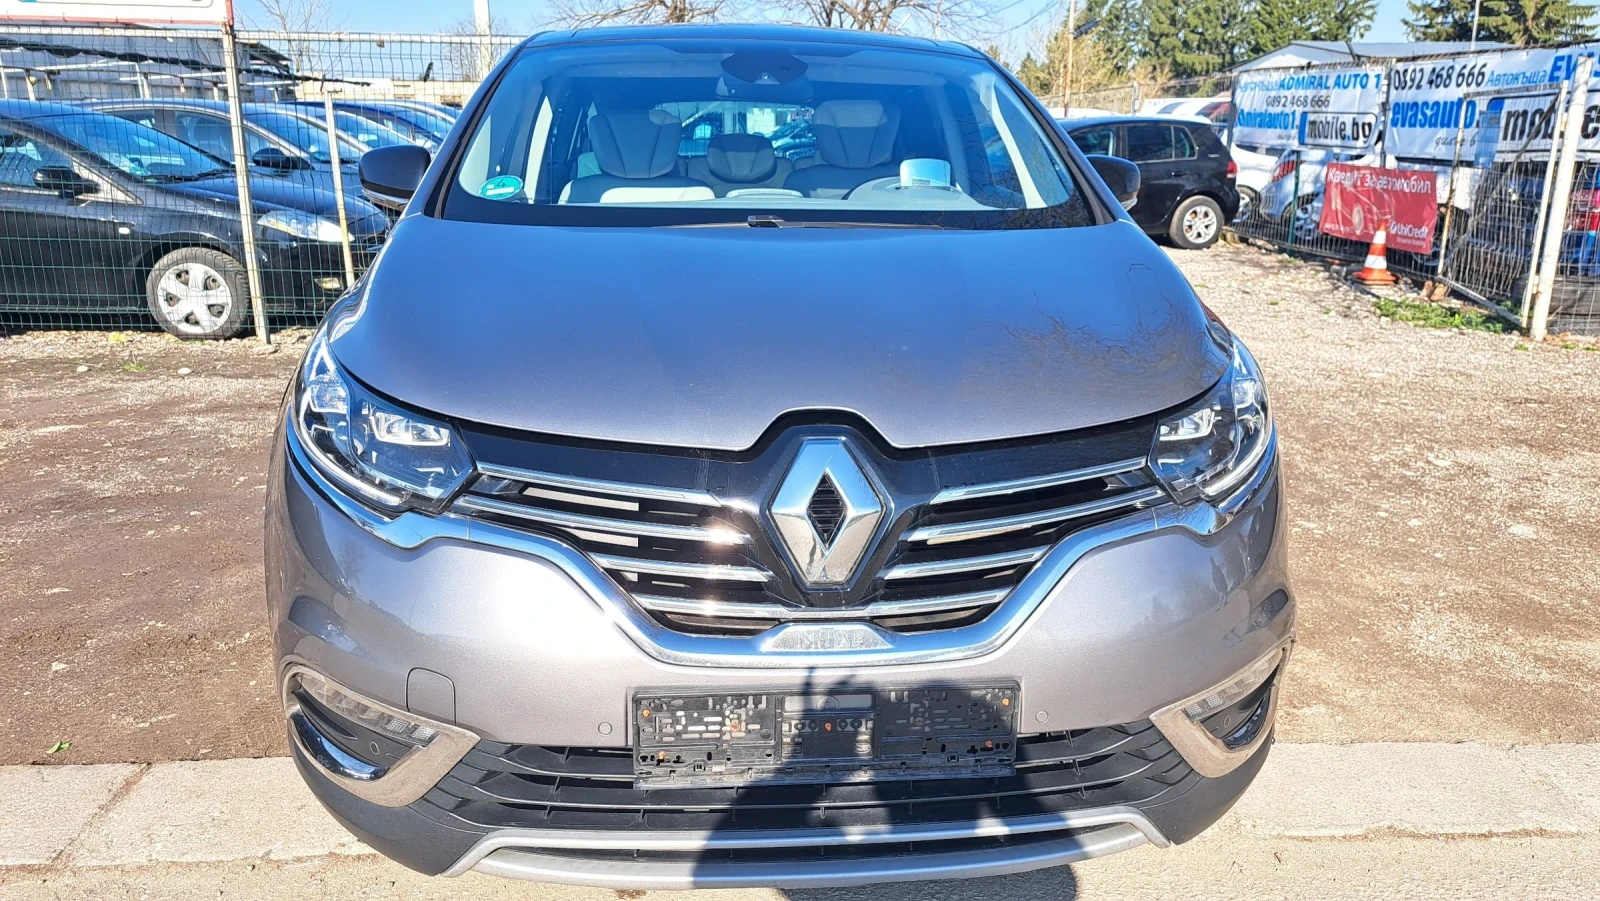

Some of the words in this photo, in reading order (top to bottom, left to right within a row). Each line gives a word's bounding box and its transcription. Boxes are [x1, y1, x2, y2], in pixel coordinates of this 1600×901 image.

[1393, 67, 1424, 91] 0892
[1427, 65, 1455, 89] 468
[1456, 63, 1487, 87] 666
[1485, 69, 1547, 87] Автокъща
[1548, 51, 1600, 82] EV
[1279, 74, 1330, 91] ADMIRAL
[1333, 73, 1369, 89] AUTO
[1374, 73, 1382, 89] 1
[1289, 95, 1309, 108] 468
[1310, 94, 1330, 108] 666
[1308, 116, 1372, 143] mobile.bg
[496, 179, 507, 188] 4
